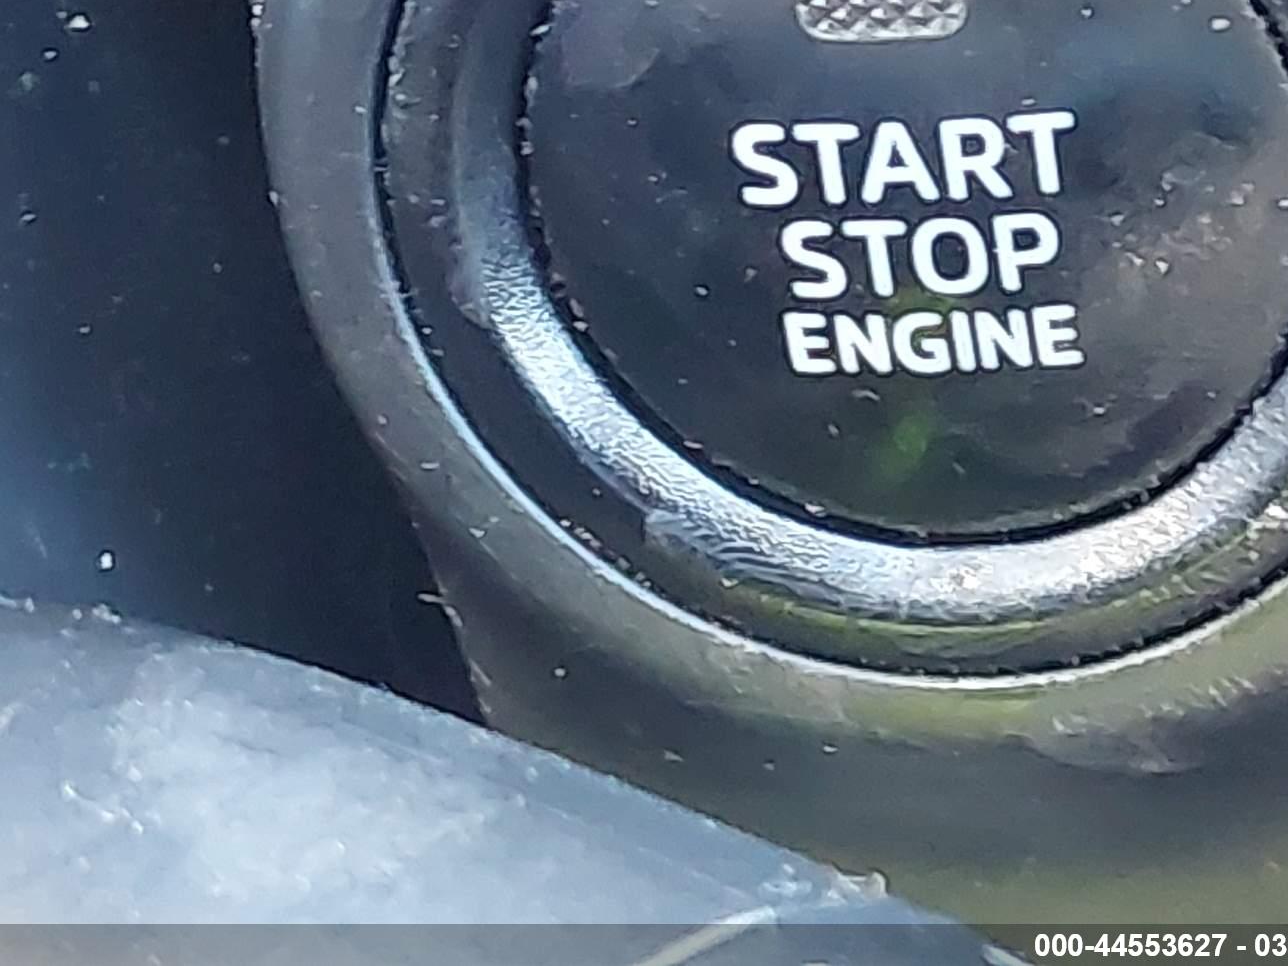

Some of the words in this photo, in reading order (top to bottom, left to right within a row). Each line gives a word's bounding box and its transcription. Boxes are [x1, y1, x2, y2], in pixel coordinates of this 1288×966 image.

[731, 110, 1076, 206] START
[780, 212, 1060, 299] STOP
[782, 304, 1085, 374] ENGINE
